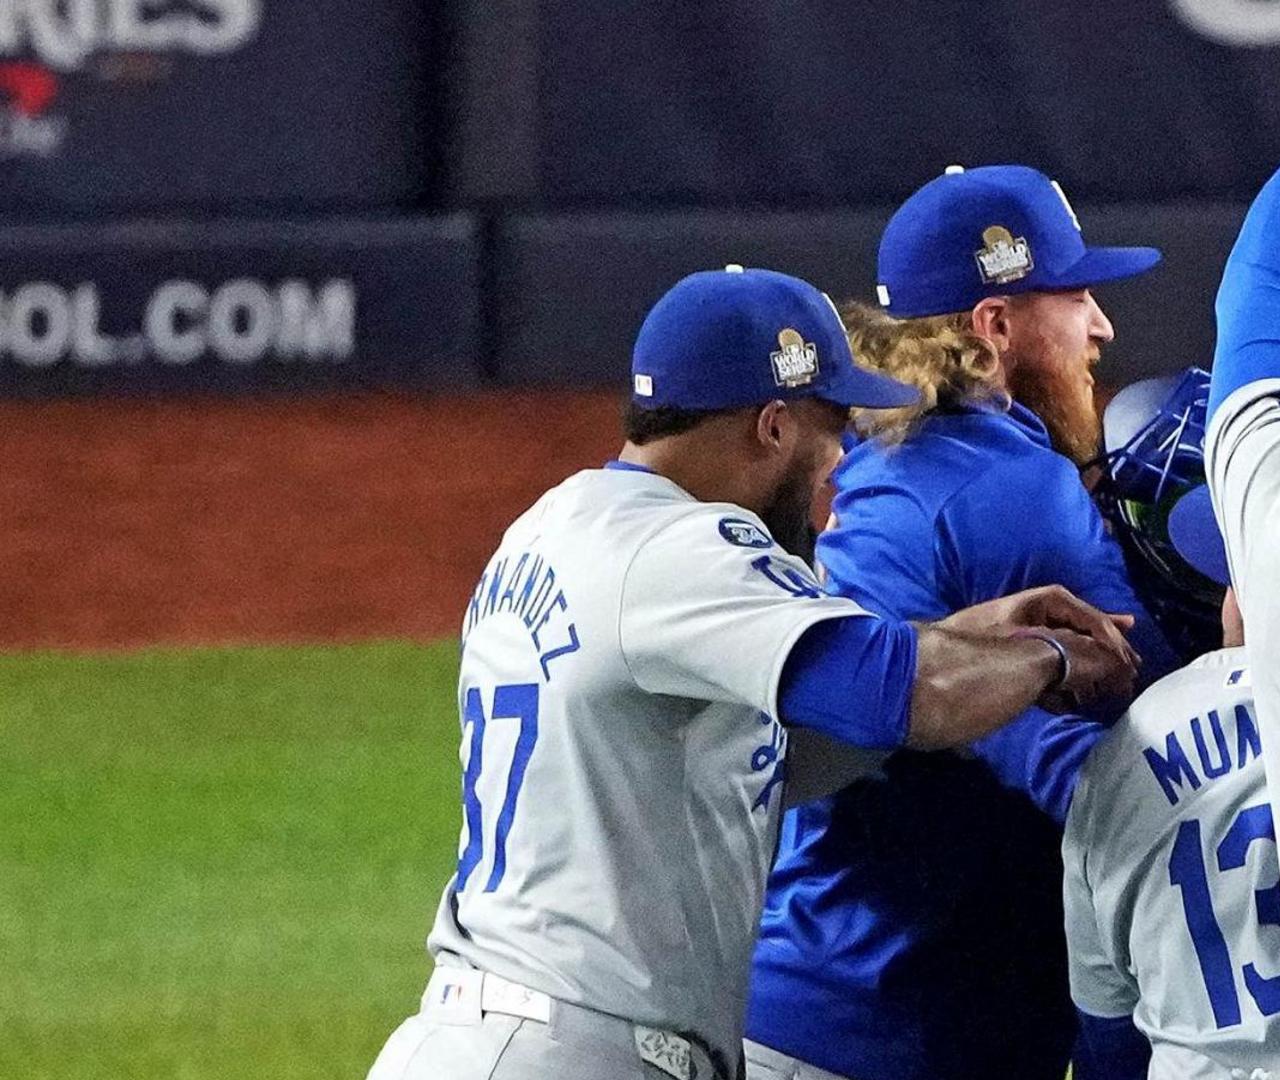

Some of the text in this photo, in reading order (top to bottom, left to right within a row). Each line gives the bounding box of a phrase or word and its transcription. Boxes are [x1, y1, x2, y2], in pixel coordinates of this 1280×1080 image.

[0, 277, 356, 366] OL.COM
[462, 552, 581, 683] RNANDEZ
[456, 683, 539, 893] 37
